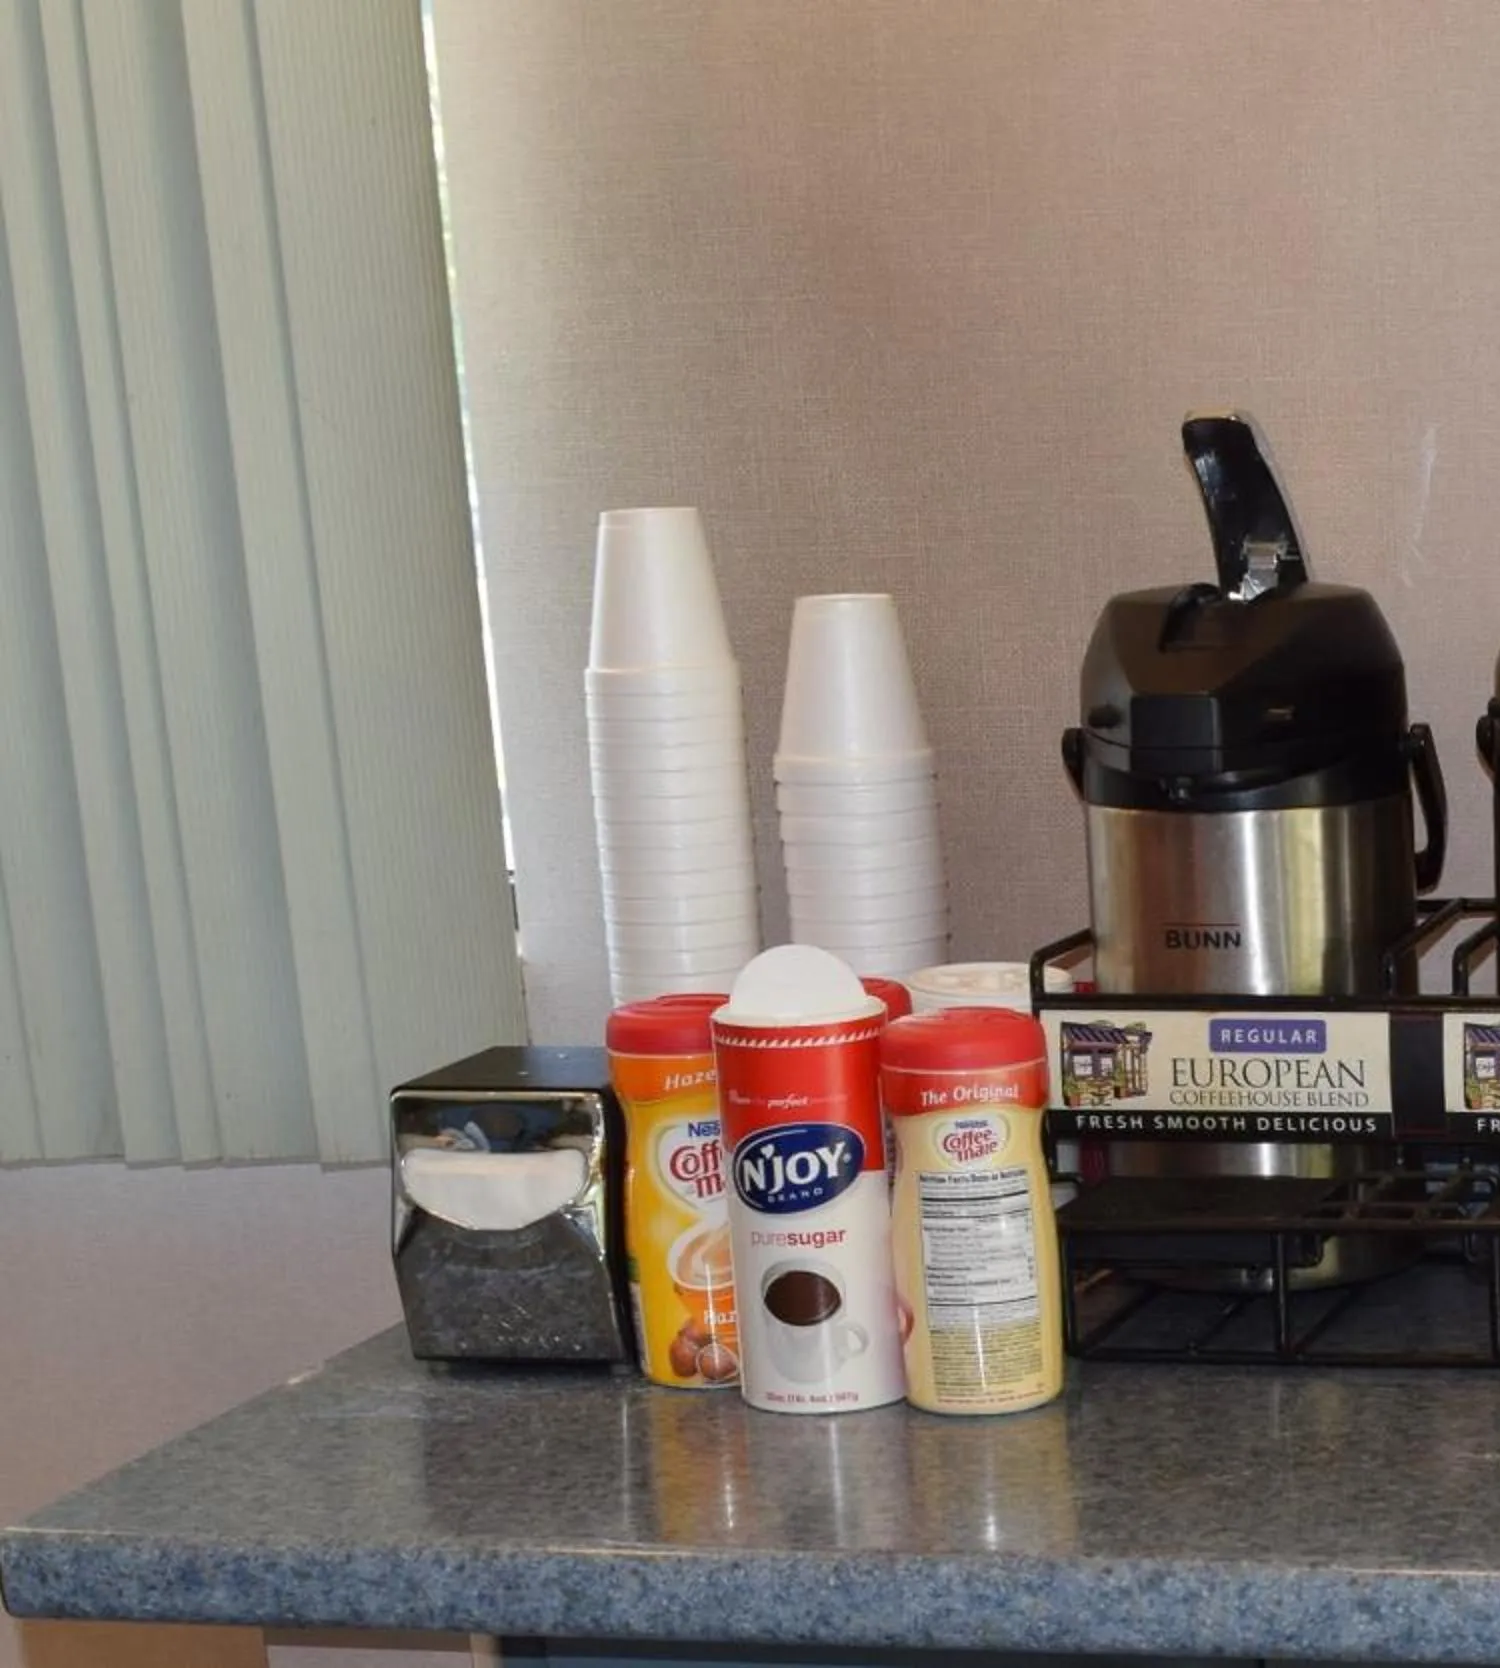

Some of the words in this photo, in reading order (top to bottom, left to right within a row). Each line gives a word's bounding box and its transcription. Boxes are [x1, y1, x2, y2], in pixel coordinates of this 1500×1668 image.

[1165, 929, 1242, 950] BUNN
[1220, 1028, 1318, 1044] REGULAR
[1171, 1057, 1366, 1089] EUROPEAN
[920, 1090, 948, 1107] The
[953, 1083, 1020, 1103] Original
[1169, 1089, 1302, 1108] COFFEEHOUSE
[1307, 1091, 1370, 1109] BLEND
[1075, 1114, 1144, 1130] FRESH
[1153, 1115, 1247, 1131] SMOOTH
[1256, 1117, 1378, 1133] DELICIOUS
[669, 1139, 723, 1181] Coff
[957, 1141, 998, 1163] mate
[767, 1187, 824, 1204] BRAND
